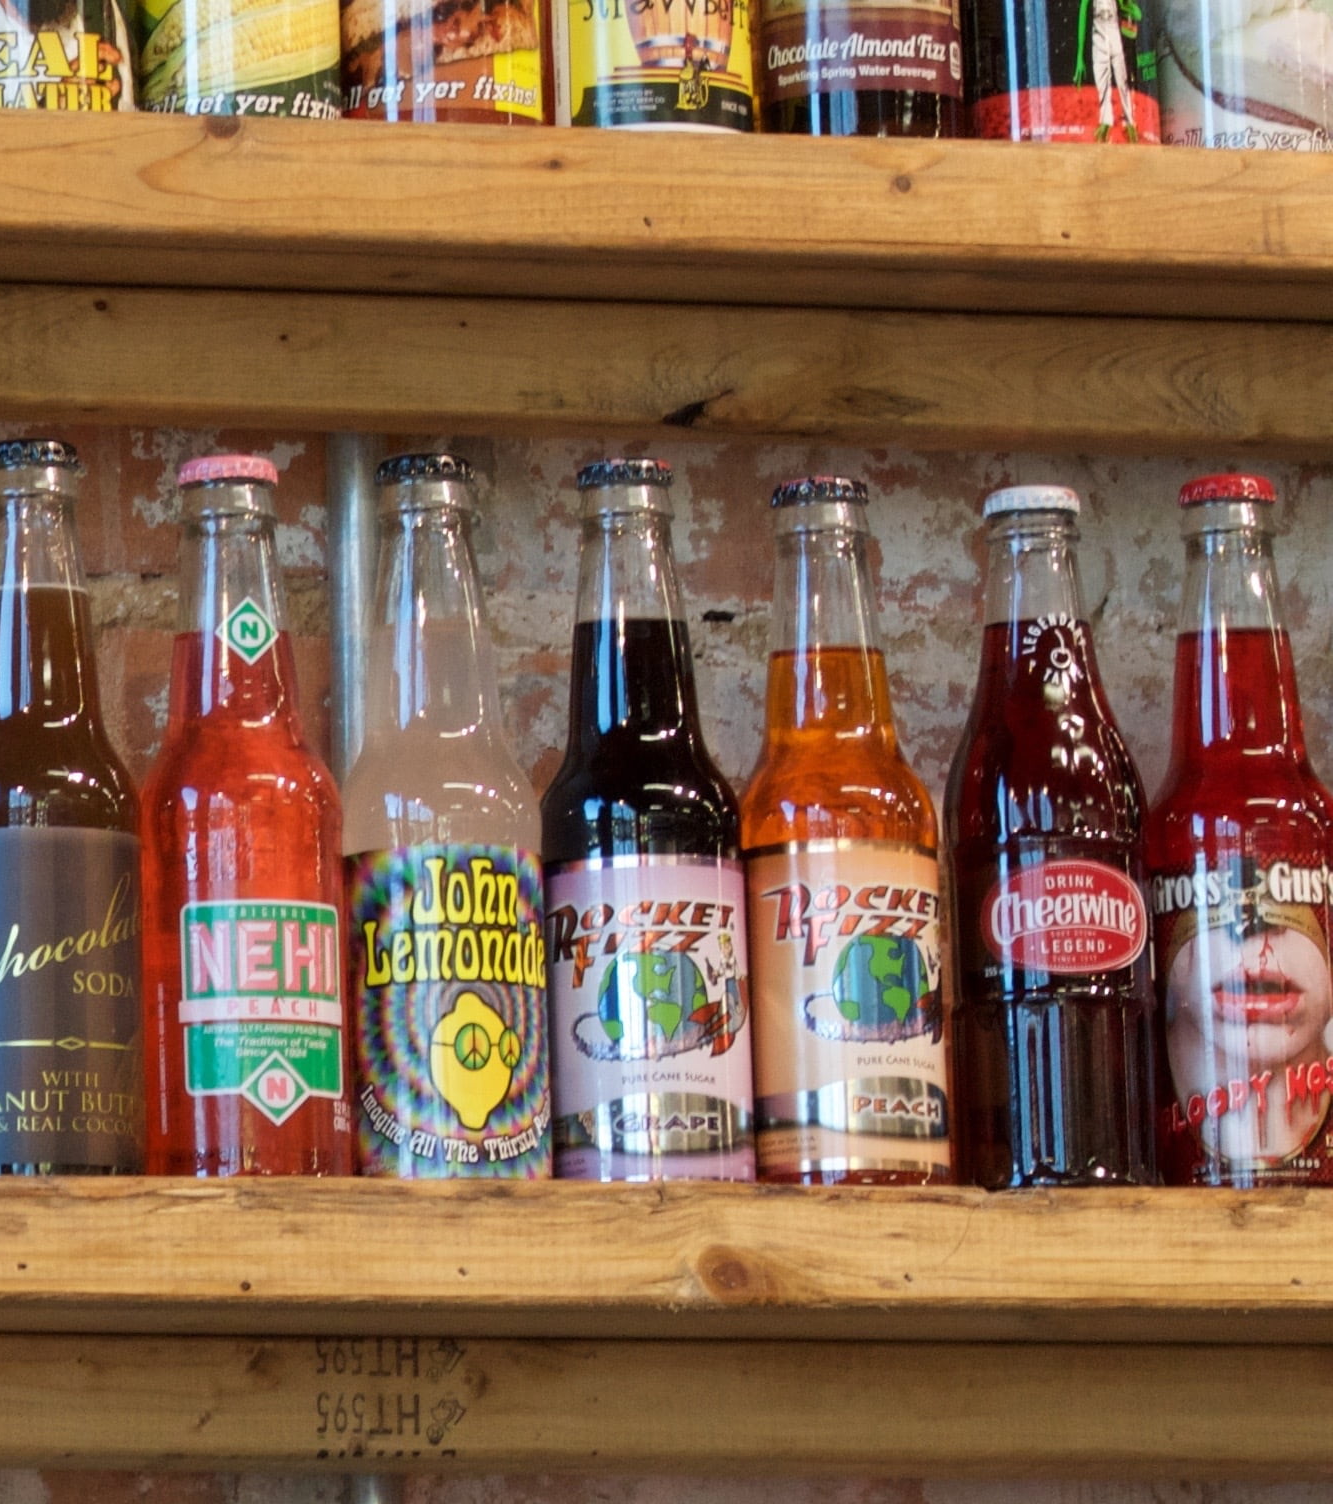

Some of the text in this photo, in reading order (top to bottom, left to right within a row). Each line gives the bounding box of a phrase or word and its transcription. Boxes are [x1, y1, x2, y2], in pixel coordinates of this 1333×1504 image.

[767, 35, 946, 70] Chocolate Almond Fizz
[820, 66, 857, 85] Spring
[859, 65, 891, 79] Water
[892, 66, 937, 82] Beverage
[413, 857, 518, 925] John
[1044, 875, 1094, 889] DRINK
[991, 887, 1136, 946] Cheerwine
[191, 925, 335, 994] NEHI
[363, 921, 546, 989] Lemonade
[1039, 938, 1105, 954] LEGEND
[225, 999, 319, 1018] PEACH
